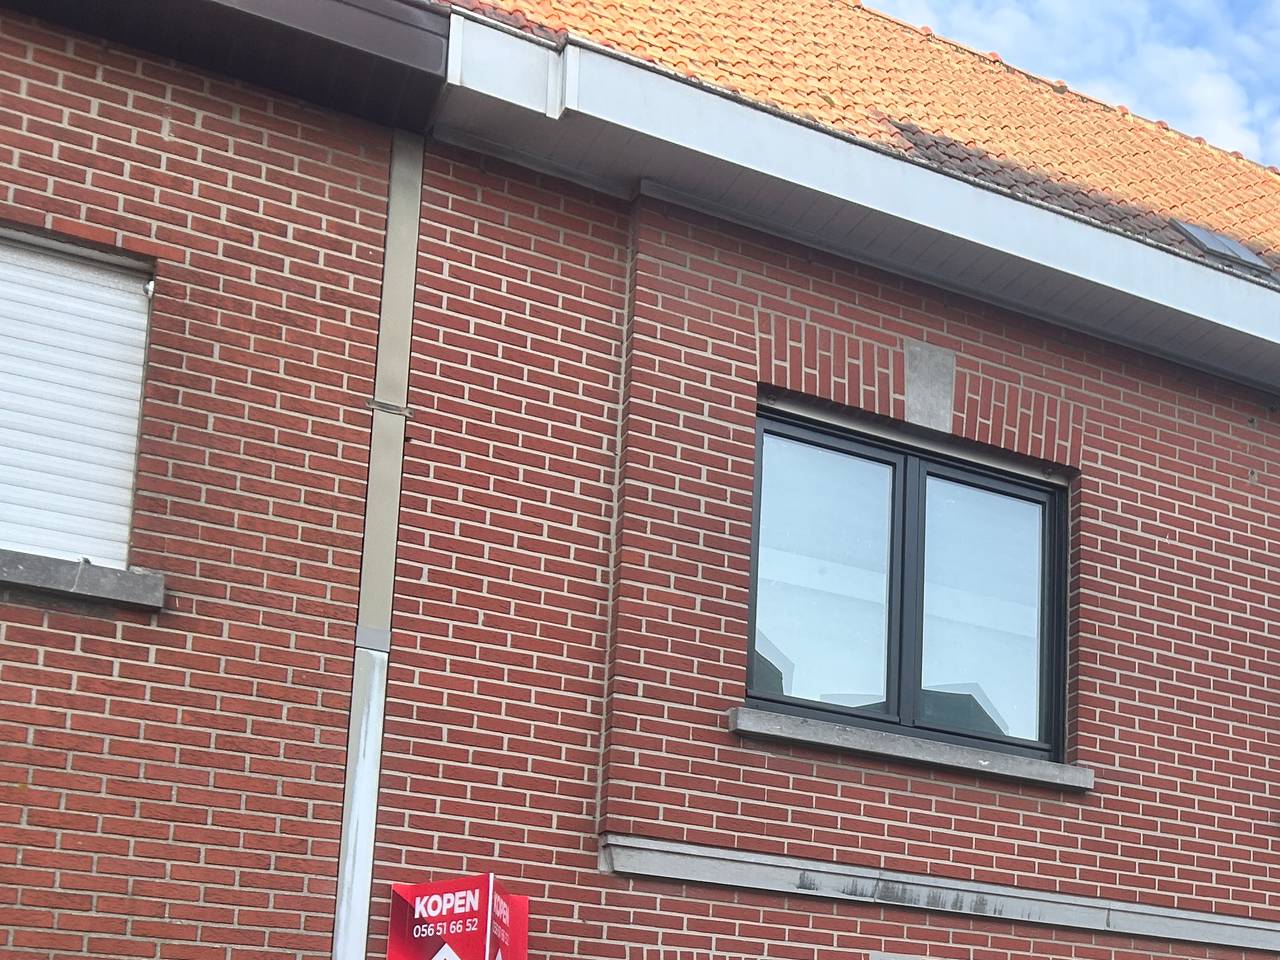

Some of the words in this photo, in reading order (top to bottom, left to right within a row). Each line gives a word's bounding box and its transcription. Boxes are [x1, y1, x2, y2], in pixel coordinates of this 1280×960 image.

[414, 889, 480, 919] KOPEN
[413, 924, 435, 938] 056
[435, 921, 447, 936] 51
[449, 920, 463, 934] 66
[465, 918, 478, 932] 52
